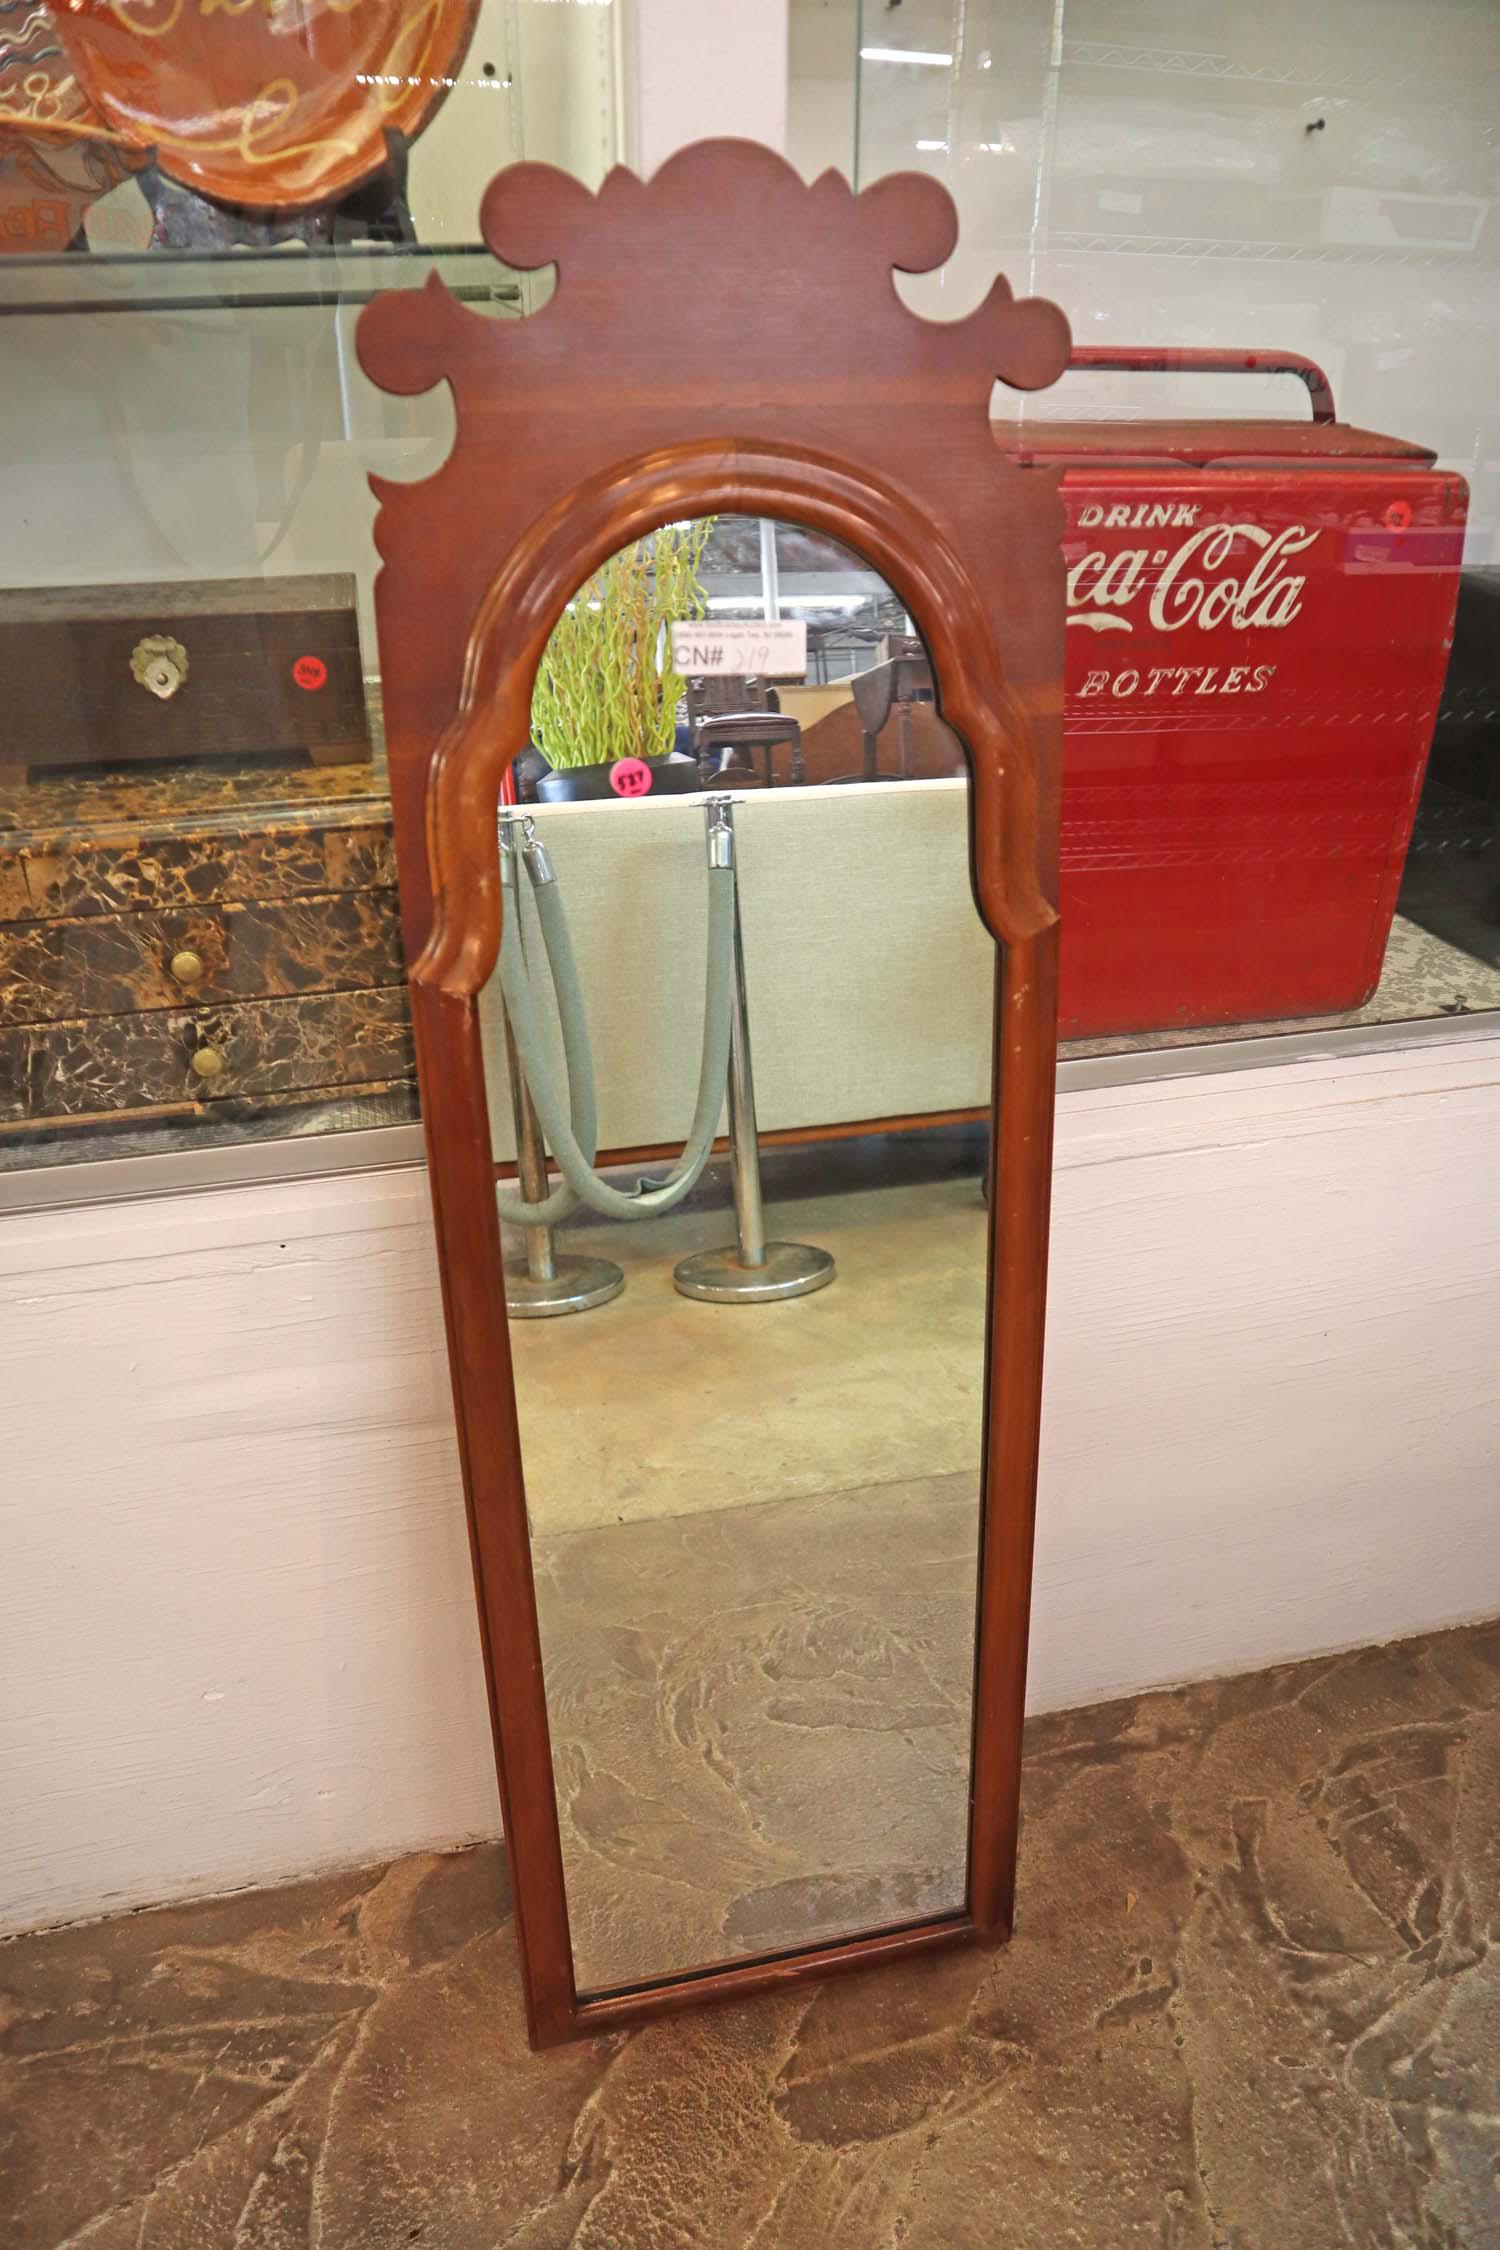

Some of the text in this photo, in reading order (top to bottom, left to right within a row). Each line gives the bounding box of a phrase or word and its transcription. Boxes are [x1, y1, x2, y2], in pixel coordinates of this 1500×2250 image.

[1077, 503, 1202, 529] DRINK
[1066, 522, 1322, 632] ca-Cola
[675, 645, 723, 667] CN#
[1078, 666, 1276, 698] BOTTLES
